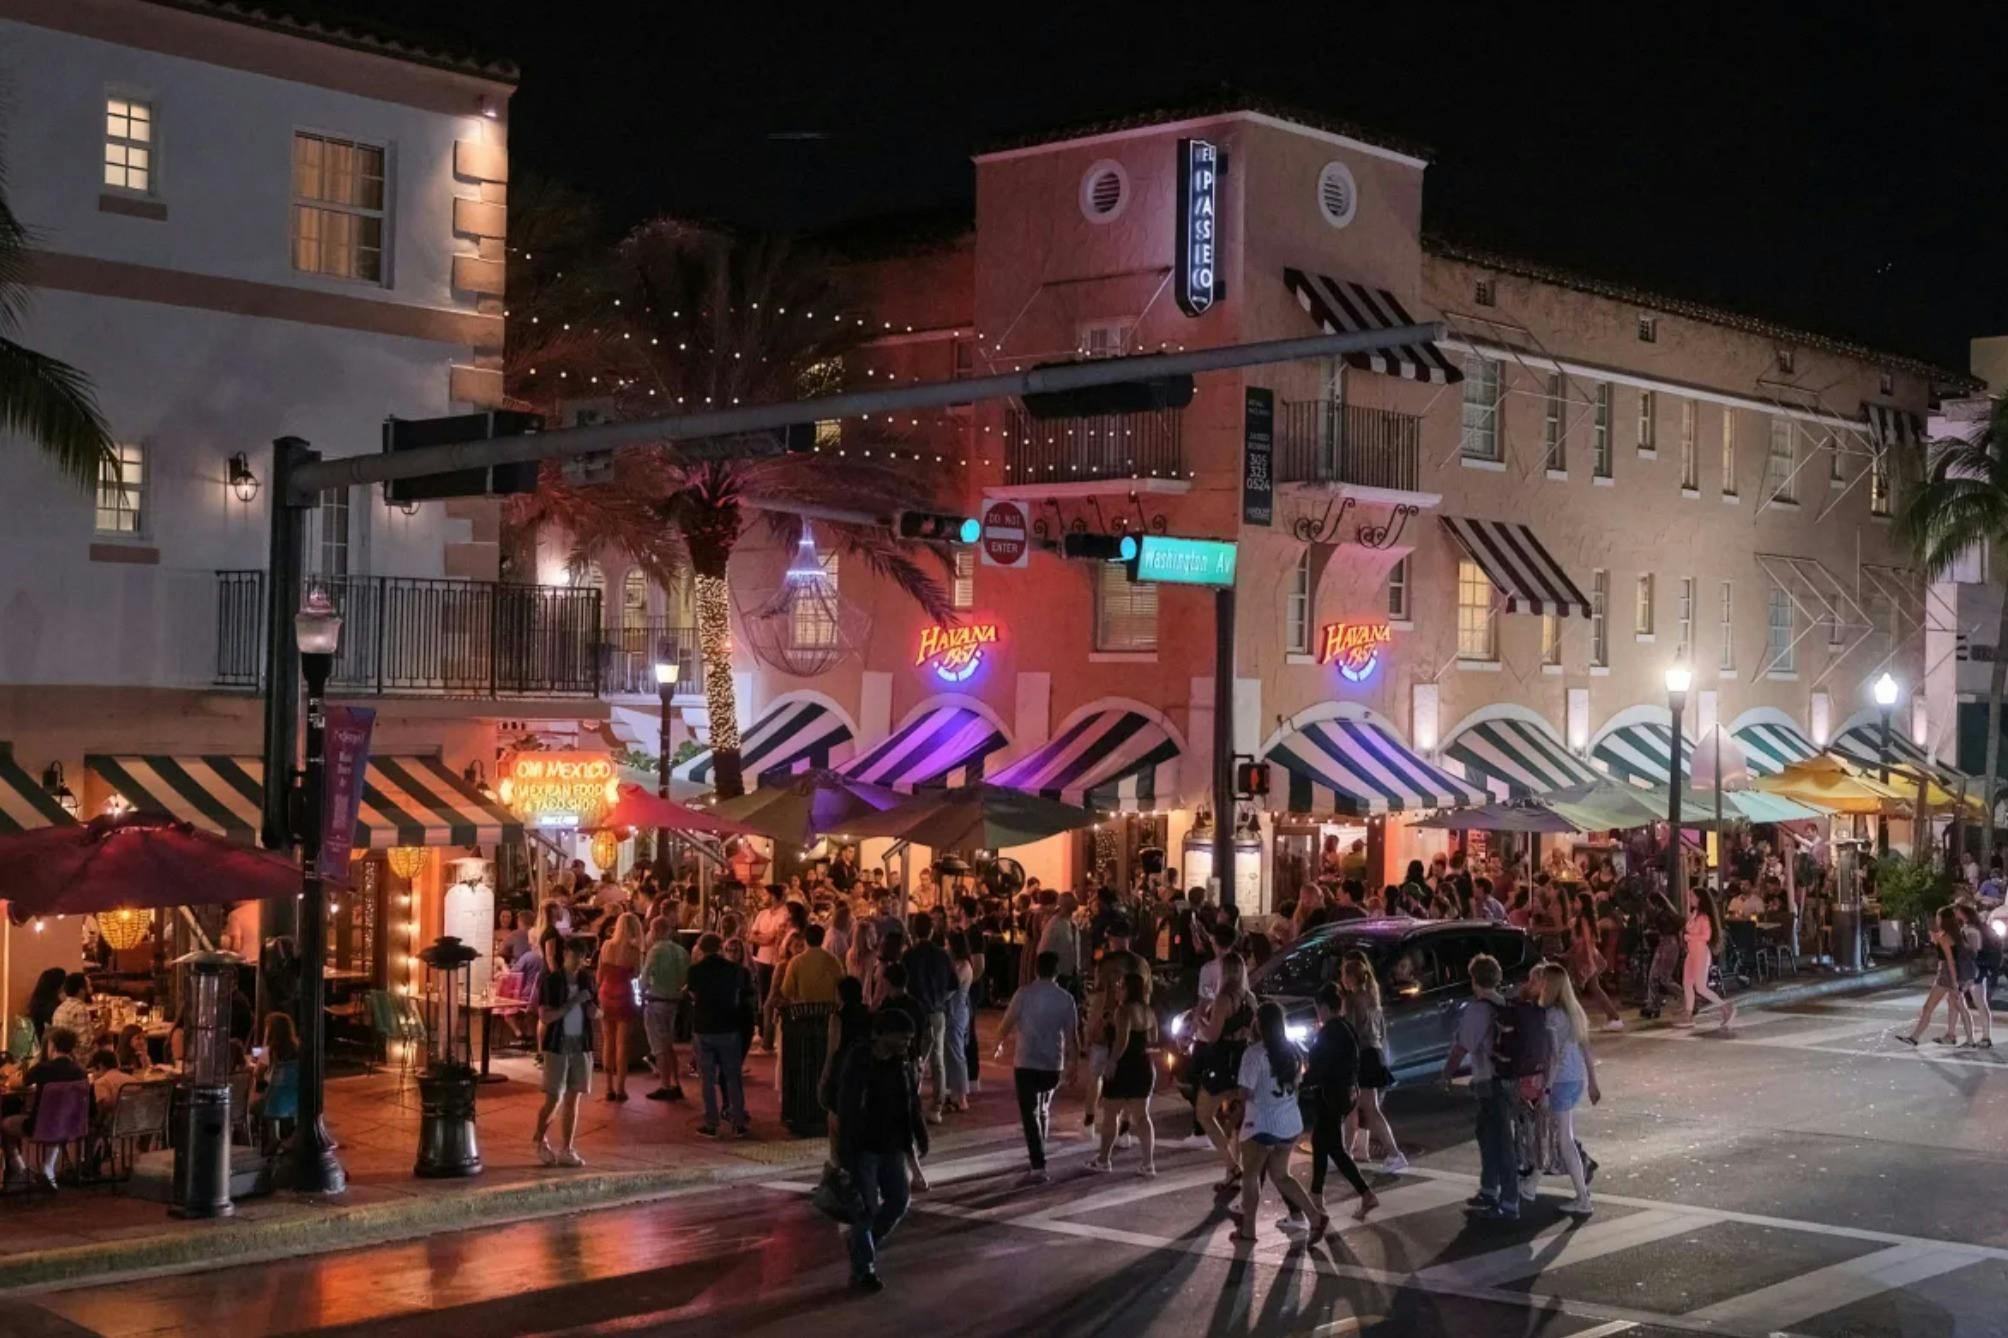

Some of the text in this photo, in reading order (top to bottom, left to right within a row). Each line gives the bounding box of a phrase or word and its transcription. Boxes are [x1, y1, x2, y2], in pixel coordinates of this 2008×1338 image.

[1202, 148, 1214, 162] EL
[1199, 170, 1213, 288] PASEO
[989, 514, 1020, 526] DO NOT
[991, 542, 1018, 553] ENTER
[1145, 547, 1208, 575] Washington
[916, 625, 997, 666] HAVANA
[1323, 624, 1391, 664] HAVANA
[942, 642, 978, 669] 1957
[546, 761, 611, 778] MEXICO
[573, 784, 603, 797] FOOD
